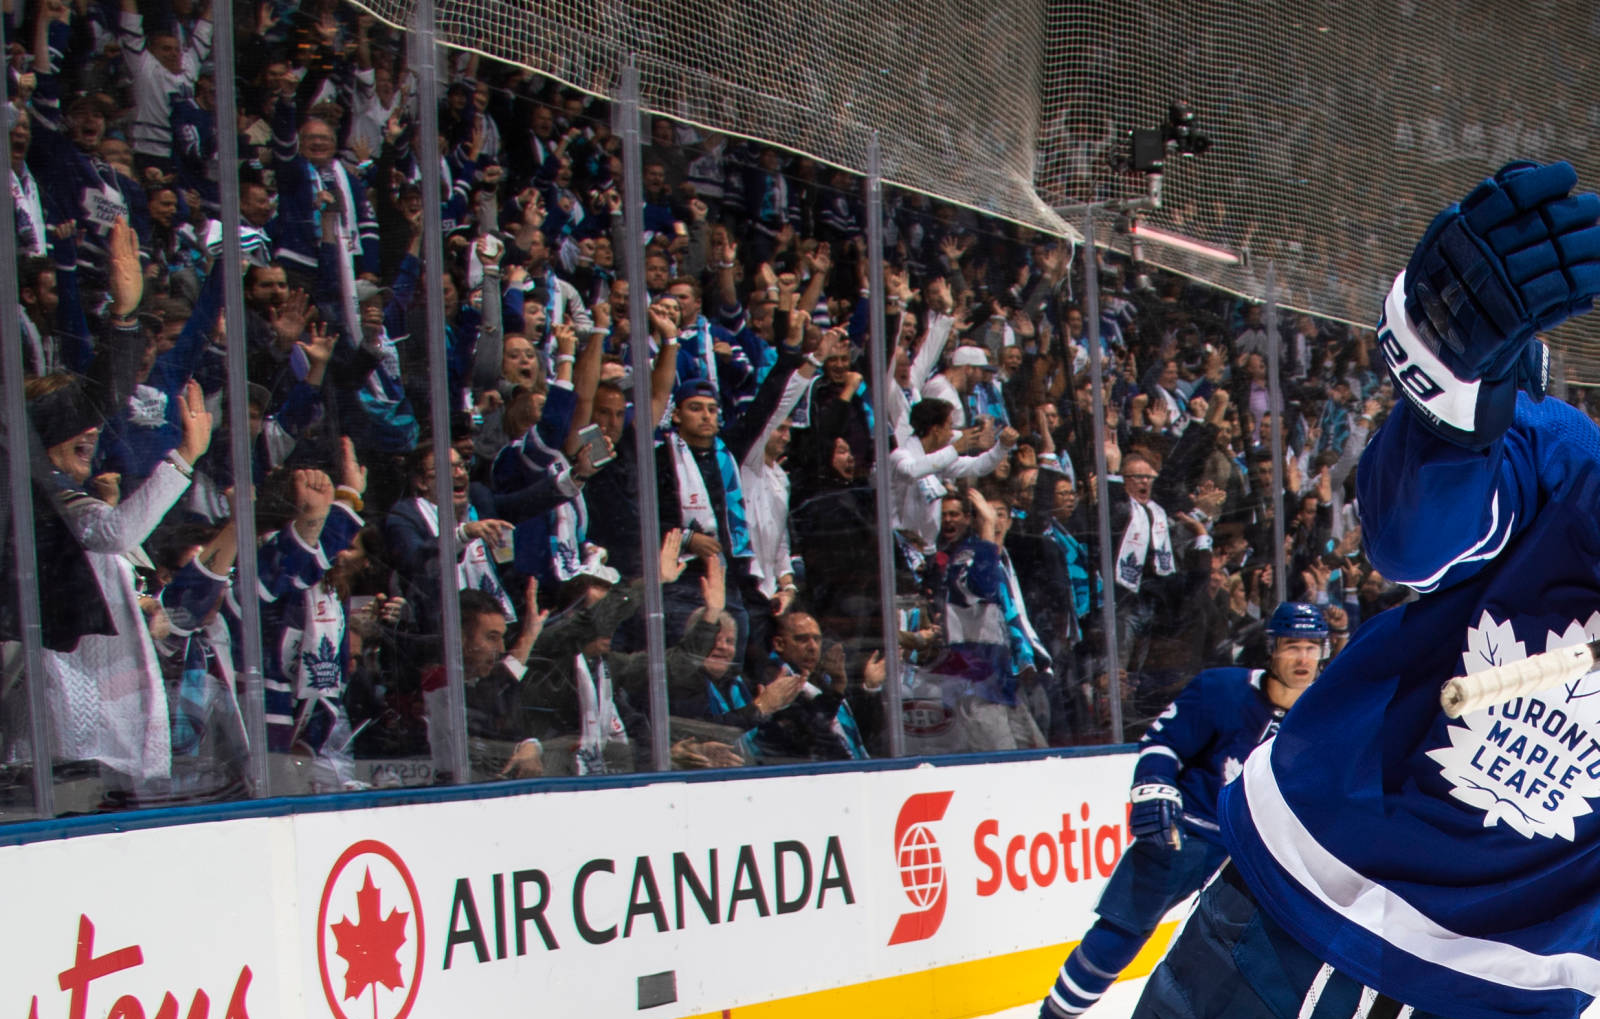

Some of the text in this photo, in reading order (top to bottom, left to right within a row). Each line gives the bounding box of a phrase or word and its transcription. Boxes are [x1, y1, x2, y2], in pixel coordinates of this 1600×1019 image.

[1470, 744, 1565, 812] LEAFS
[1487, 719, 1586, 789] MAPLE
[443, 835, 856, 970] AIR CANADA
